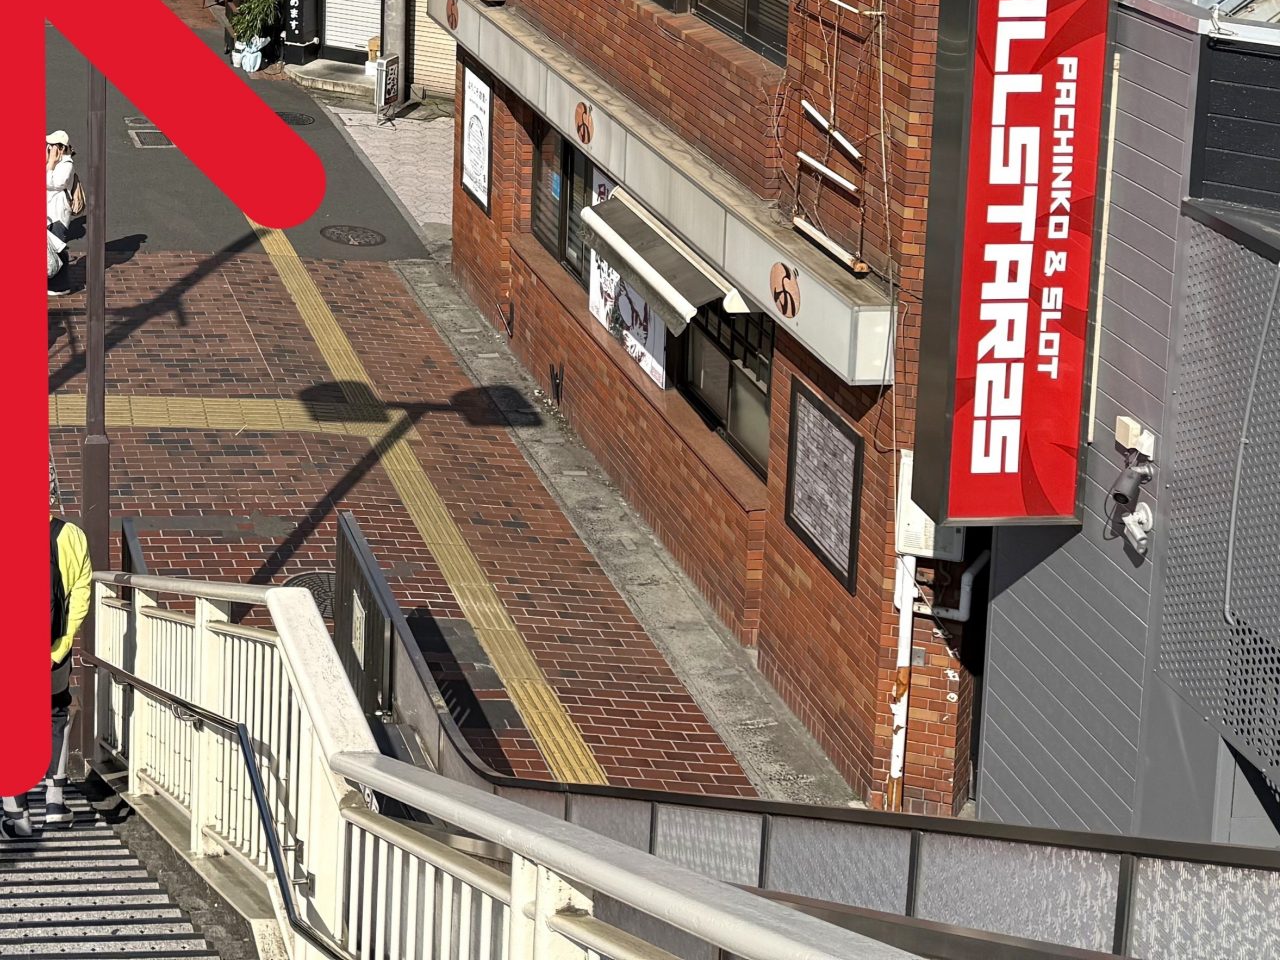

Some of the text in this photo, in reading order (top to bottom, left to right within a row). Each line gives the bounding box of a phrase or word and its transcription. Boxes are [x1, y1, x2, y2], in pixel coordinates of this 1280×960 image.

[1037, 56, 1078, 379] PACHINKO & SLOT
